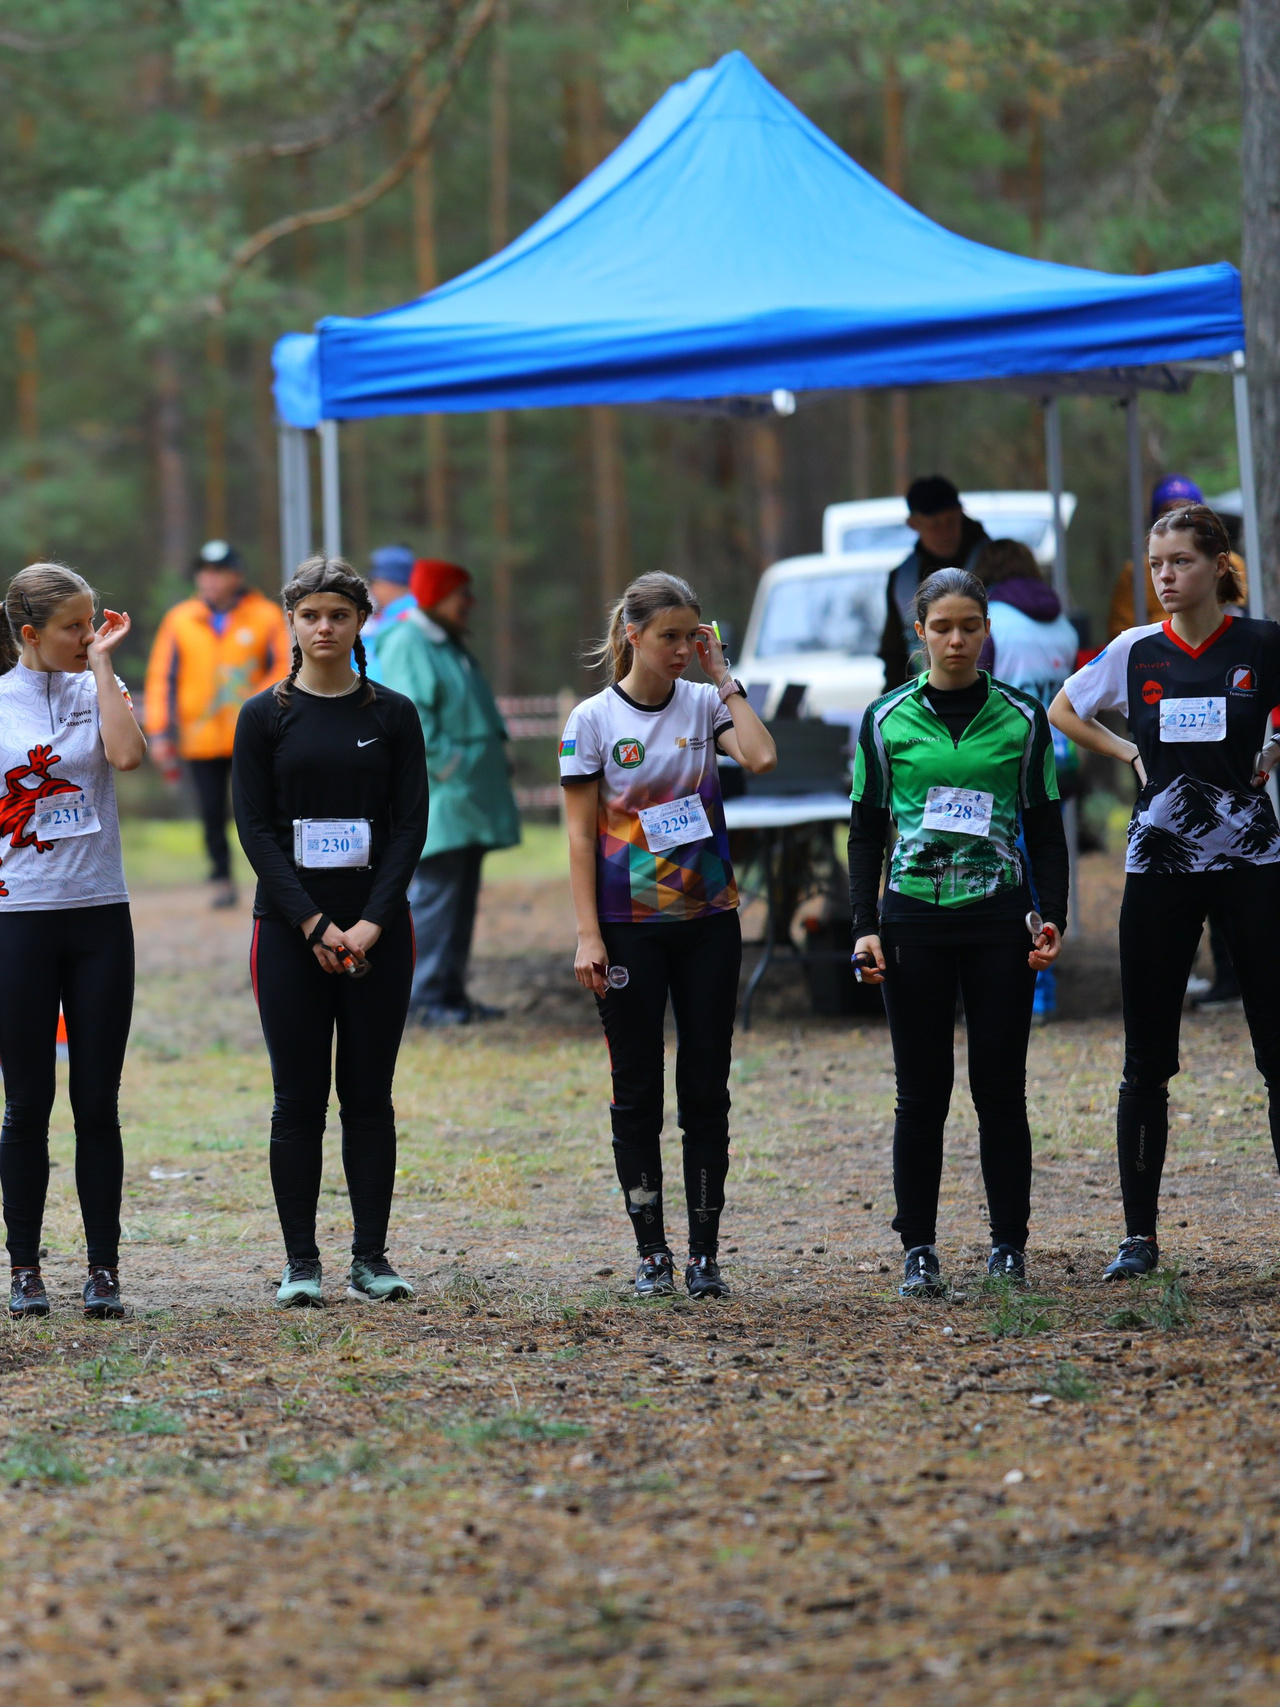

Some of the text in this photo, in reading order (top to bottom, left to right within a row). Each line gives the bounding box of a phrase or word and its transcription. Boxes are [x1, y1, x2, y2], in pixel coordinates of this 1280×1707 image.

[1178, 713, 1207, 728] 227
[53, 808, 79, 824] 231
[944, 802, 972, 819] 228
[661, 815, 689, 834] 229
[321, 838, 350, 853] 230
